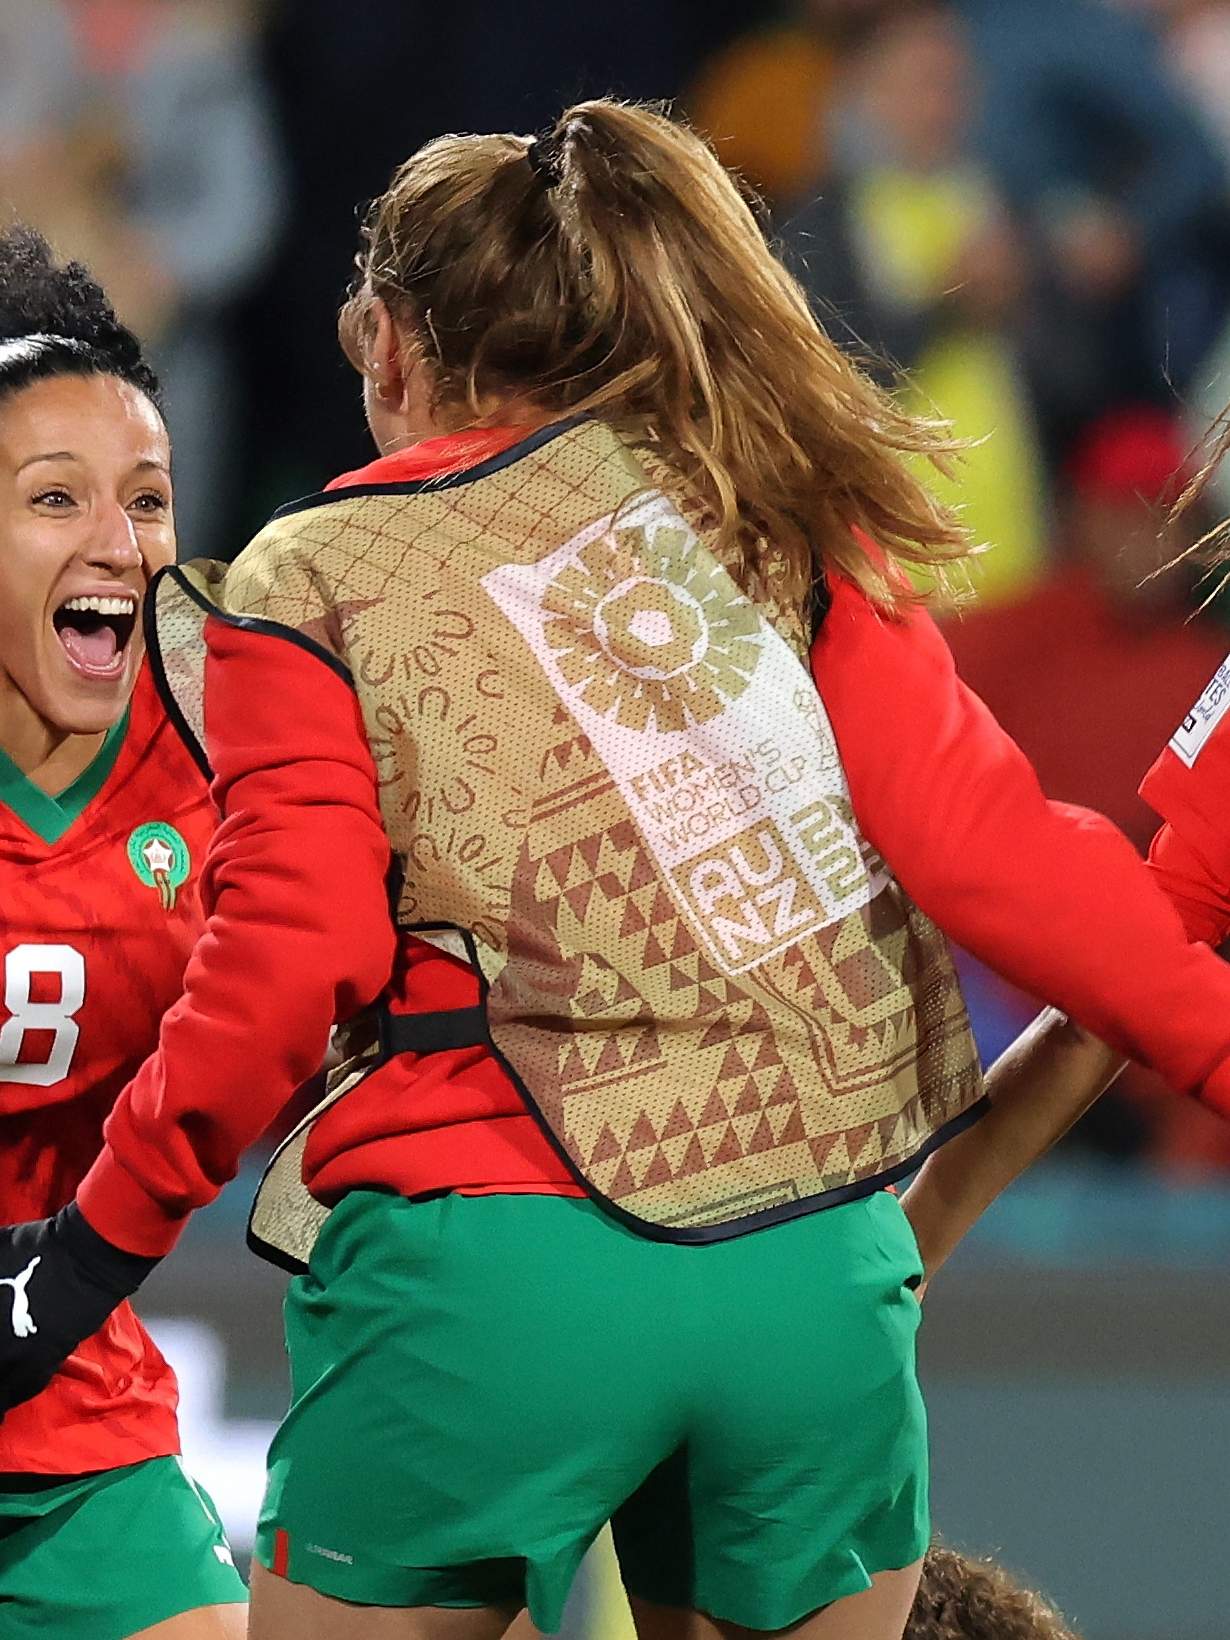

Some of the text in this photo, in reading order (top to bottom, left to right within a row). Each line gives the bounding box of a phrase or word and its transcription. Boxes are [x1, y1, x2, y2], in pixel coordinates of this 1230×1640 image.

[1205, 679, 1226, 706] TES
[629, 749, 707, 801] FIFA
[643, 738, 782, 825] WOMEN'S
[658, 754, 808, 850] WORLD CUP
[689, 829, 783, 915] AU
[710, 877, 816, 960] NZ
